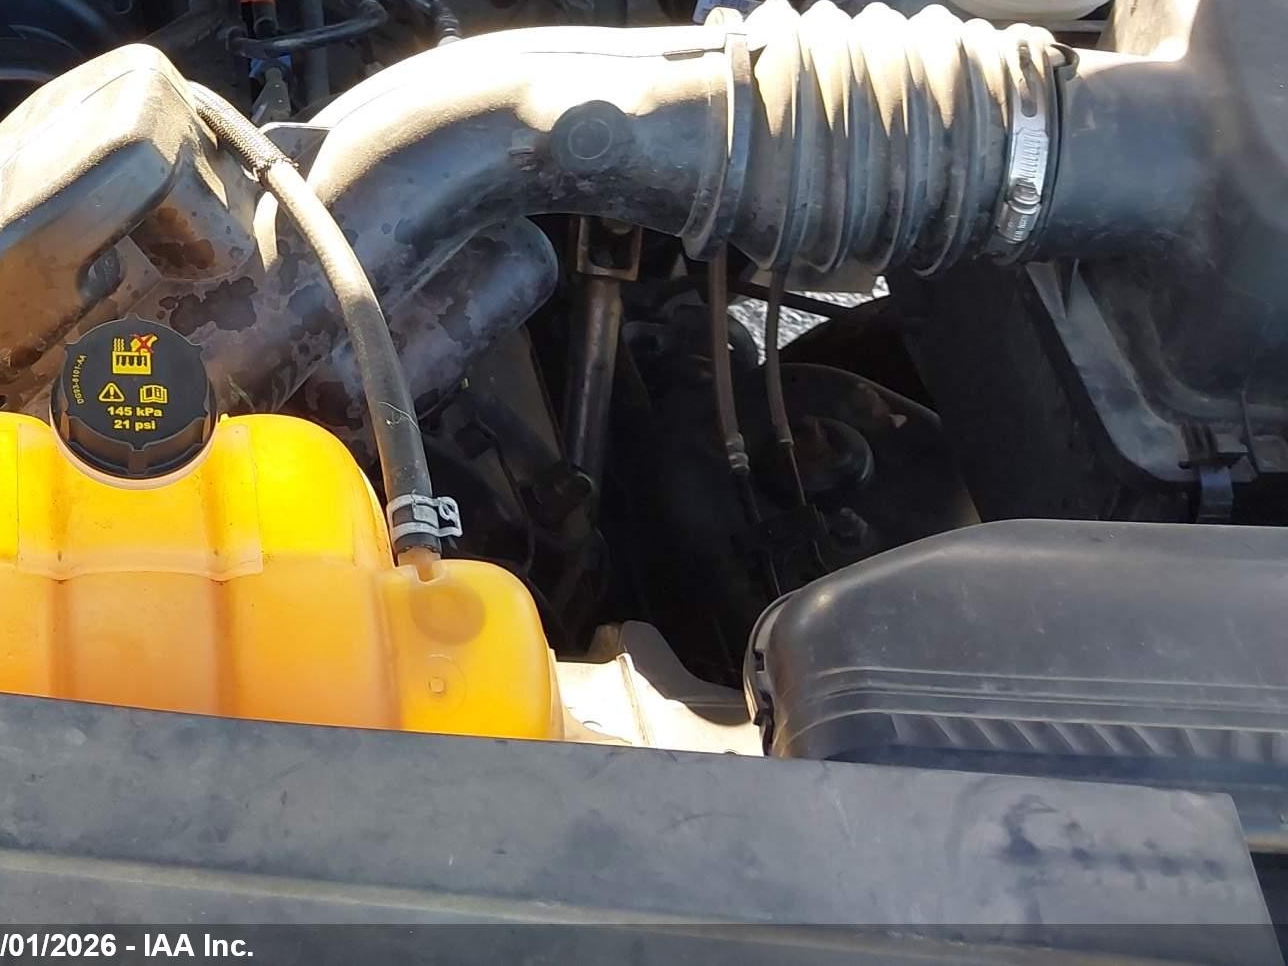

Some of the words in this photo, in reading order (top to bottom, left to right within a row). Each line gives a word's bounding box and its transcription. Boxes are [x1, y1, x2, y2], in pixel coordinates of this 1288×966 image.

[107, 407, 132, 417] 145
[136, 407, 162, 417] kPa
[113, 420, 130, 430] 21
[135, 420, 156, 431] psi
